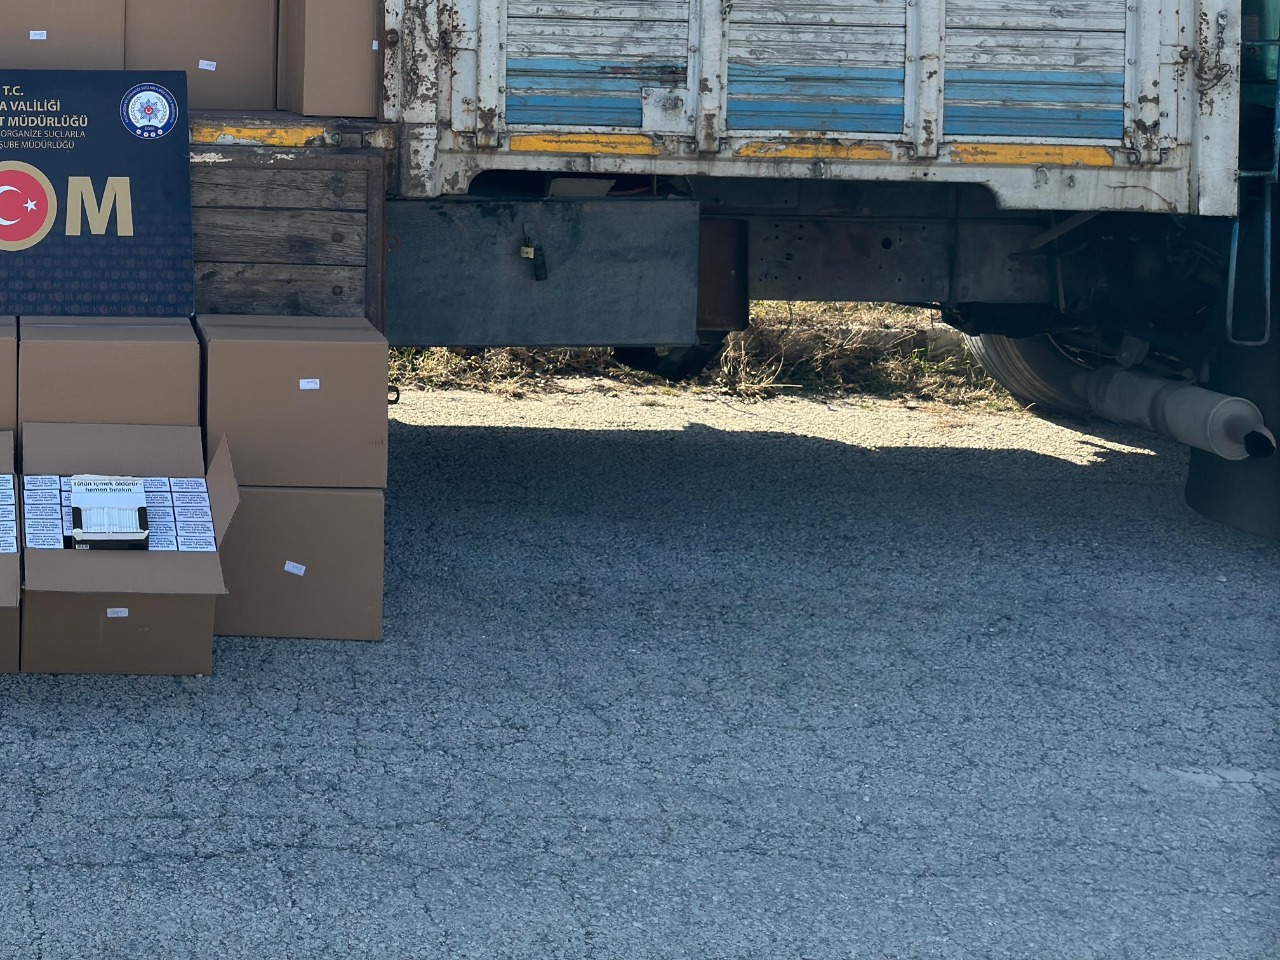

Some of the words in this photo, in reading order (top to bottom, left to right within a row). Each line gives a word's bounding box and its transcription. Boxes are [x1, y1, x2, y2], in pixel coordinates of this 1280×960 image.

[2, 85, 24, 96] T.C.
[10, 99, 61, 112] VALİLİĞİ
[8, 114, 88, 127] MÜDÜRLÜĞÜ
[0, 128, 42, 138] ORGANİZE
[44, 130, 86, 139] SUÇLARLA
[21, 139, 75, 149] MÜDÜRLÜĞÜ
